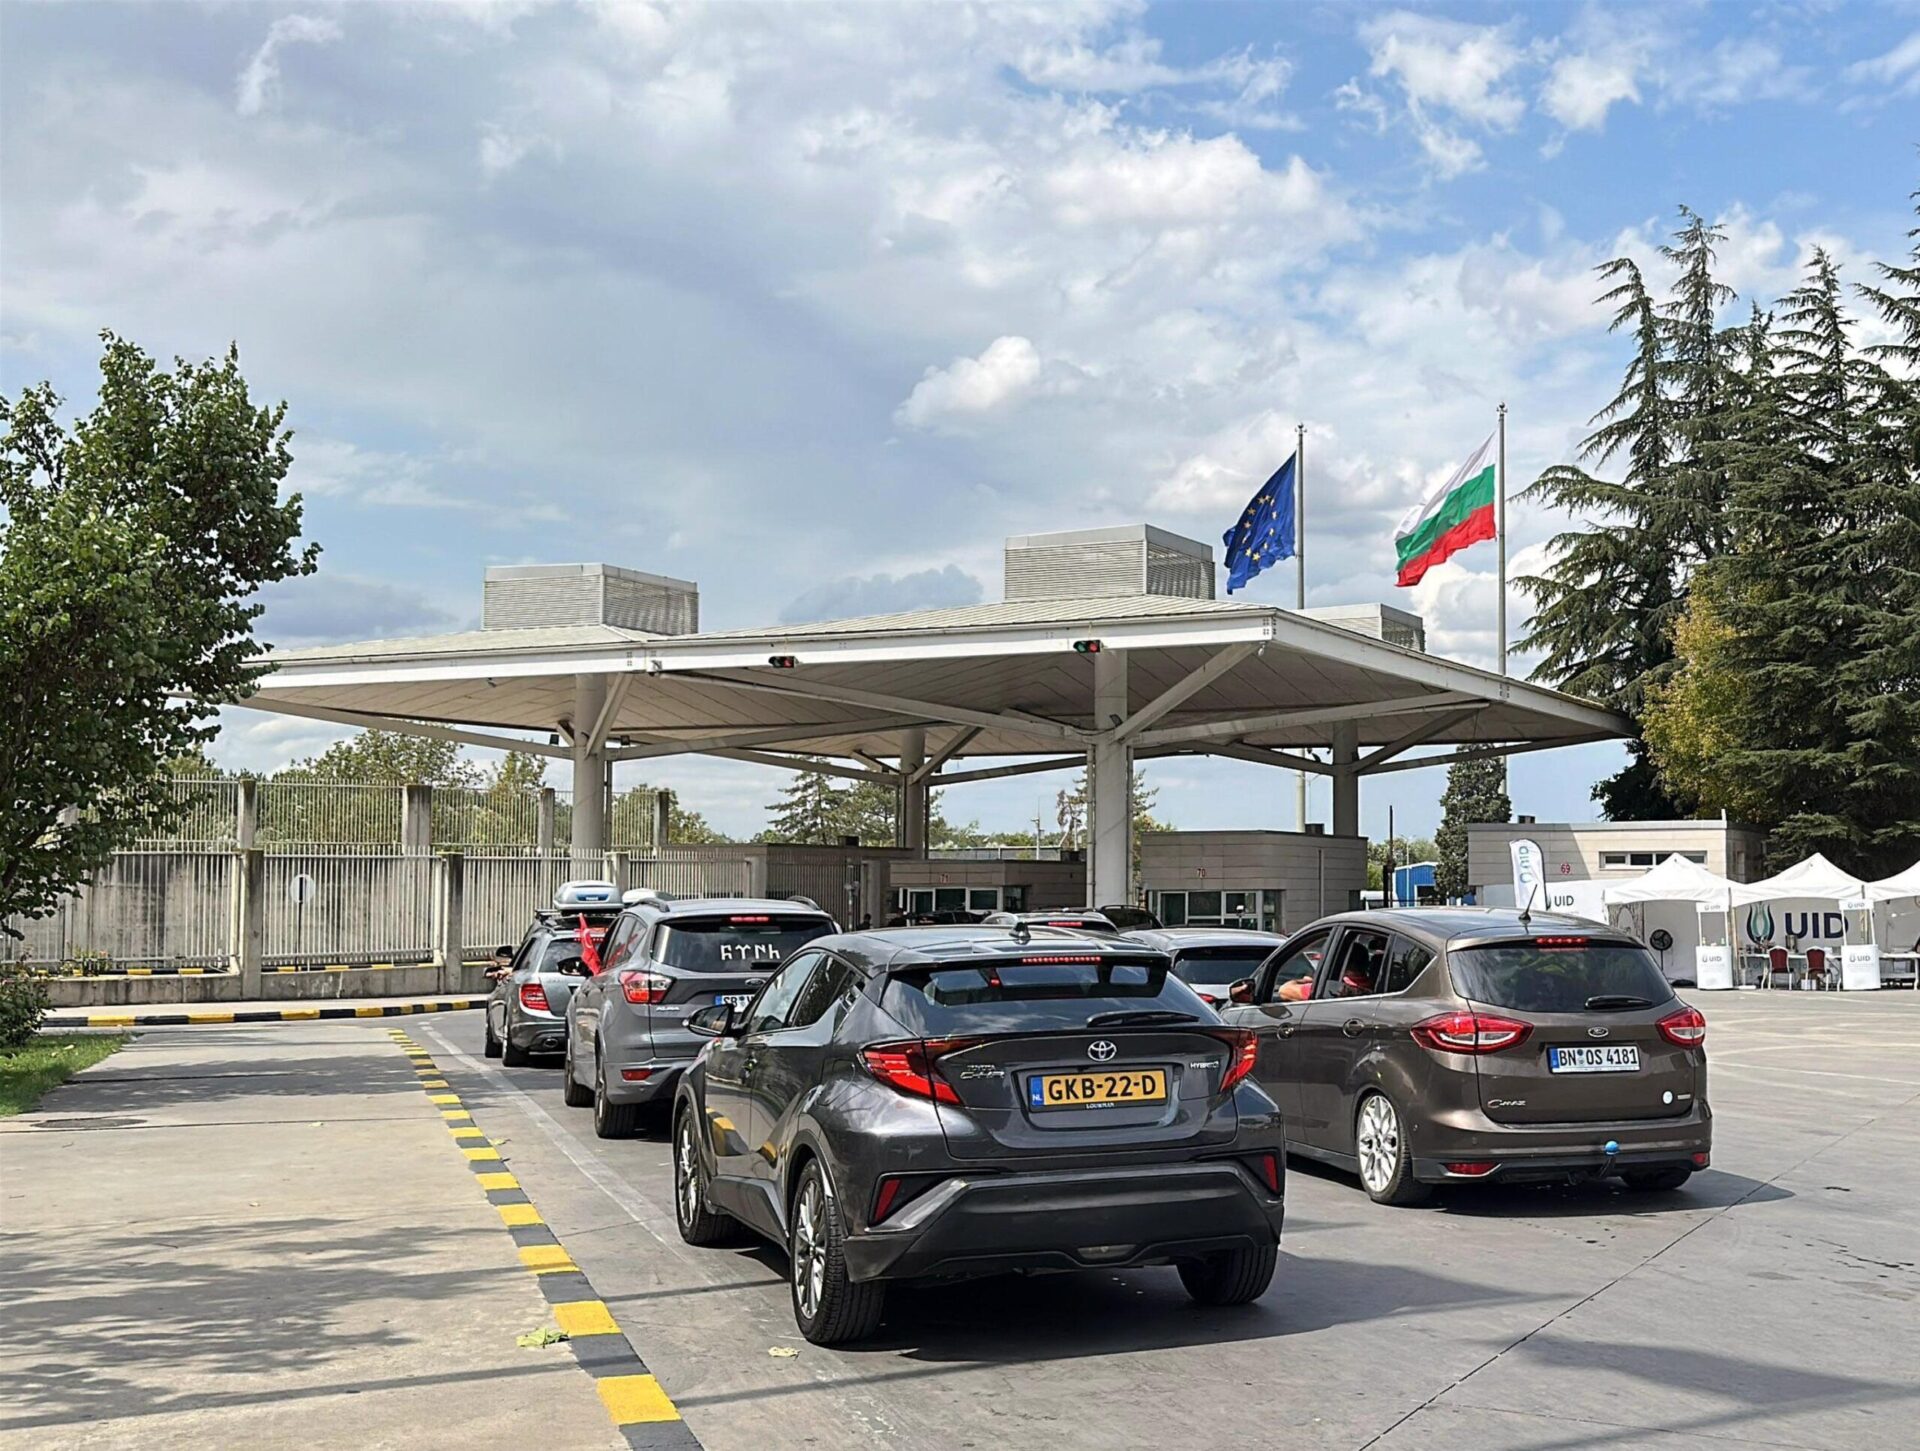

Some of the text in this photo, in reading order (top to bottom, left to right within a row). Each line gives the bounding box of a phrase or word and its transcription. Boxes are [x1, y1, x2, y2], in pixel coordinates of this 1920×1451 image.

[1554, 895, 1575, 907] UID
[1785, 912, 1849, 939] UID
[1190, 1060, 1219, 1069] HYBRID
[1559, 1048, 1638, 1066] BN OS 4181
[1048, 1074, 1156, 1101] GKB-22-D
[1032, 1094, 1043, 1102] NL
